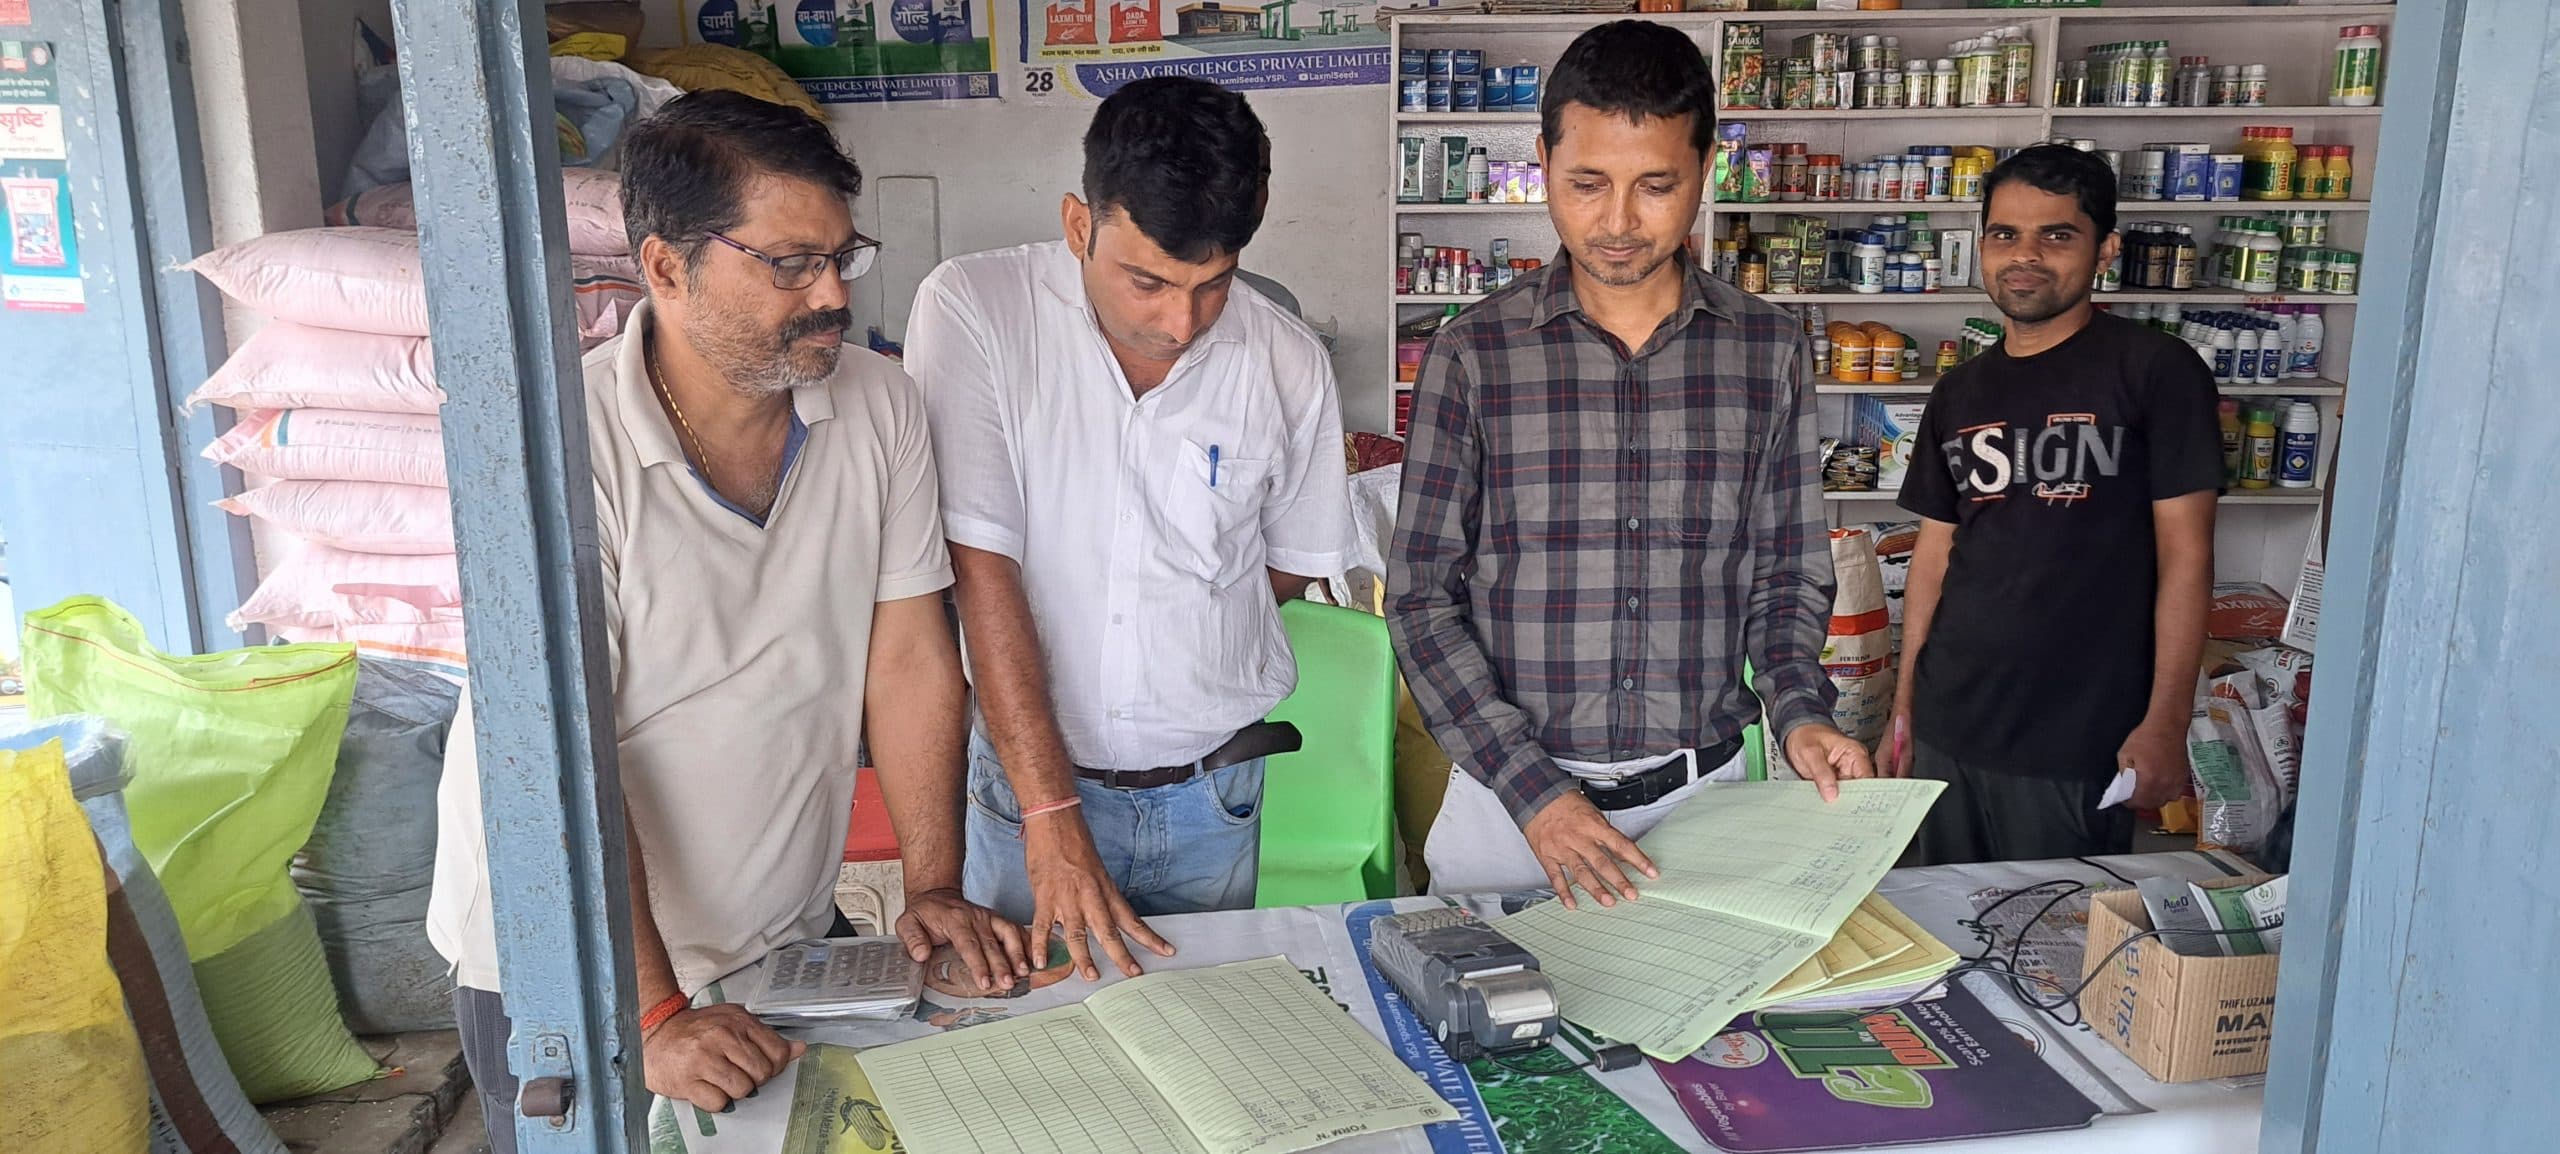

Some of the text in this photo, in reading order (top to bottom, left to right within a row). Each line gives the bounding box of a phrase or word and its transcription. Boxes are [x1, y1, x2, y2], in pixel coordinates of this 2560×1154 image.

[895, 8, 930, 25] गोल्ड
[1050, 15, 1074, 24] LAXMI
[1095, 66, 1137, 84] ASHA
[1141, 58, 1257, 80] AGRISCIENCES
[1261, 55, 1324, 71] PRIVATE
[1309, 71, 1359, 82] LaxmiSeeds
[865, 78, 907, 91] PRIVATE
[910, 77, 956, 90] LIMITED
[1025, 71, 1053, 92] 28
[1913, 1002, 1936, 1020] Mor
[1859, 1013, 1945, 1065] DUM
[1925, 1002, 1991, 1059] to Earn more!
[1936, 1027, 1960, 1044] 10%
[1956, 1044, 1984, 1067] Scan
[1422, 1035, 1465, 1099] PRIVATE
[1691, 1082, 1733, 1131] Vegetables
[1331, 1123, 1368, 1136] FORM
